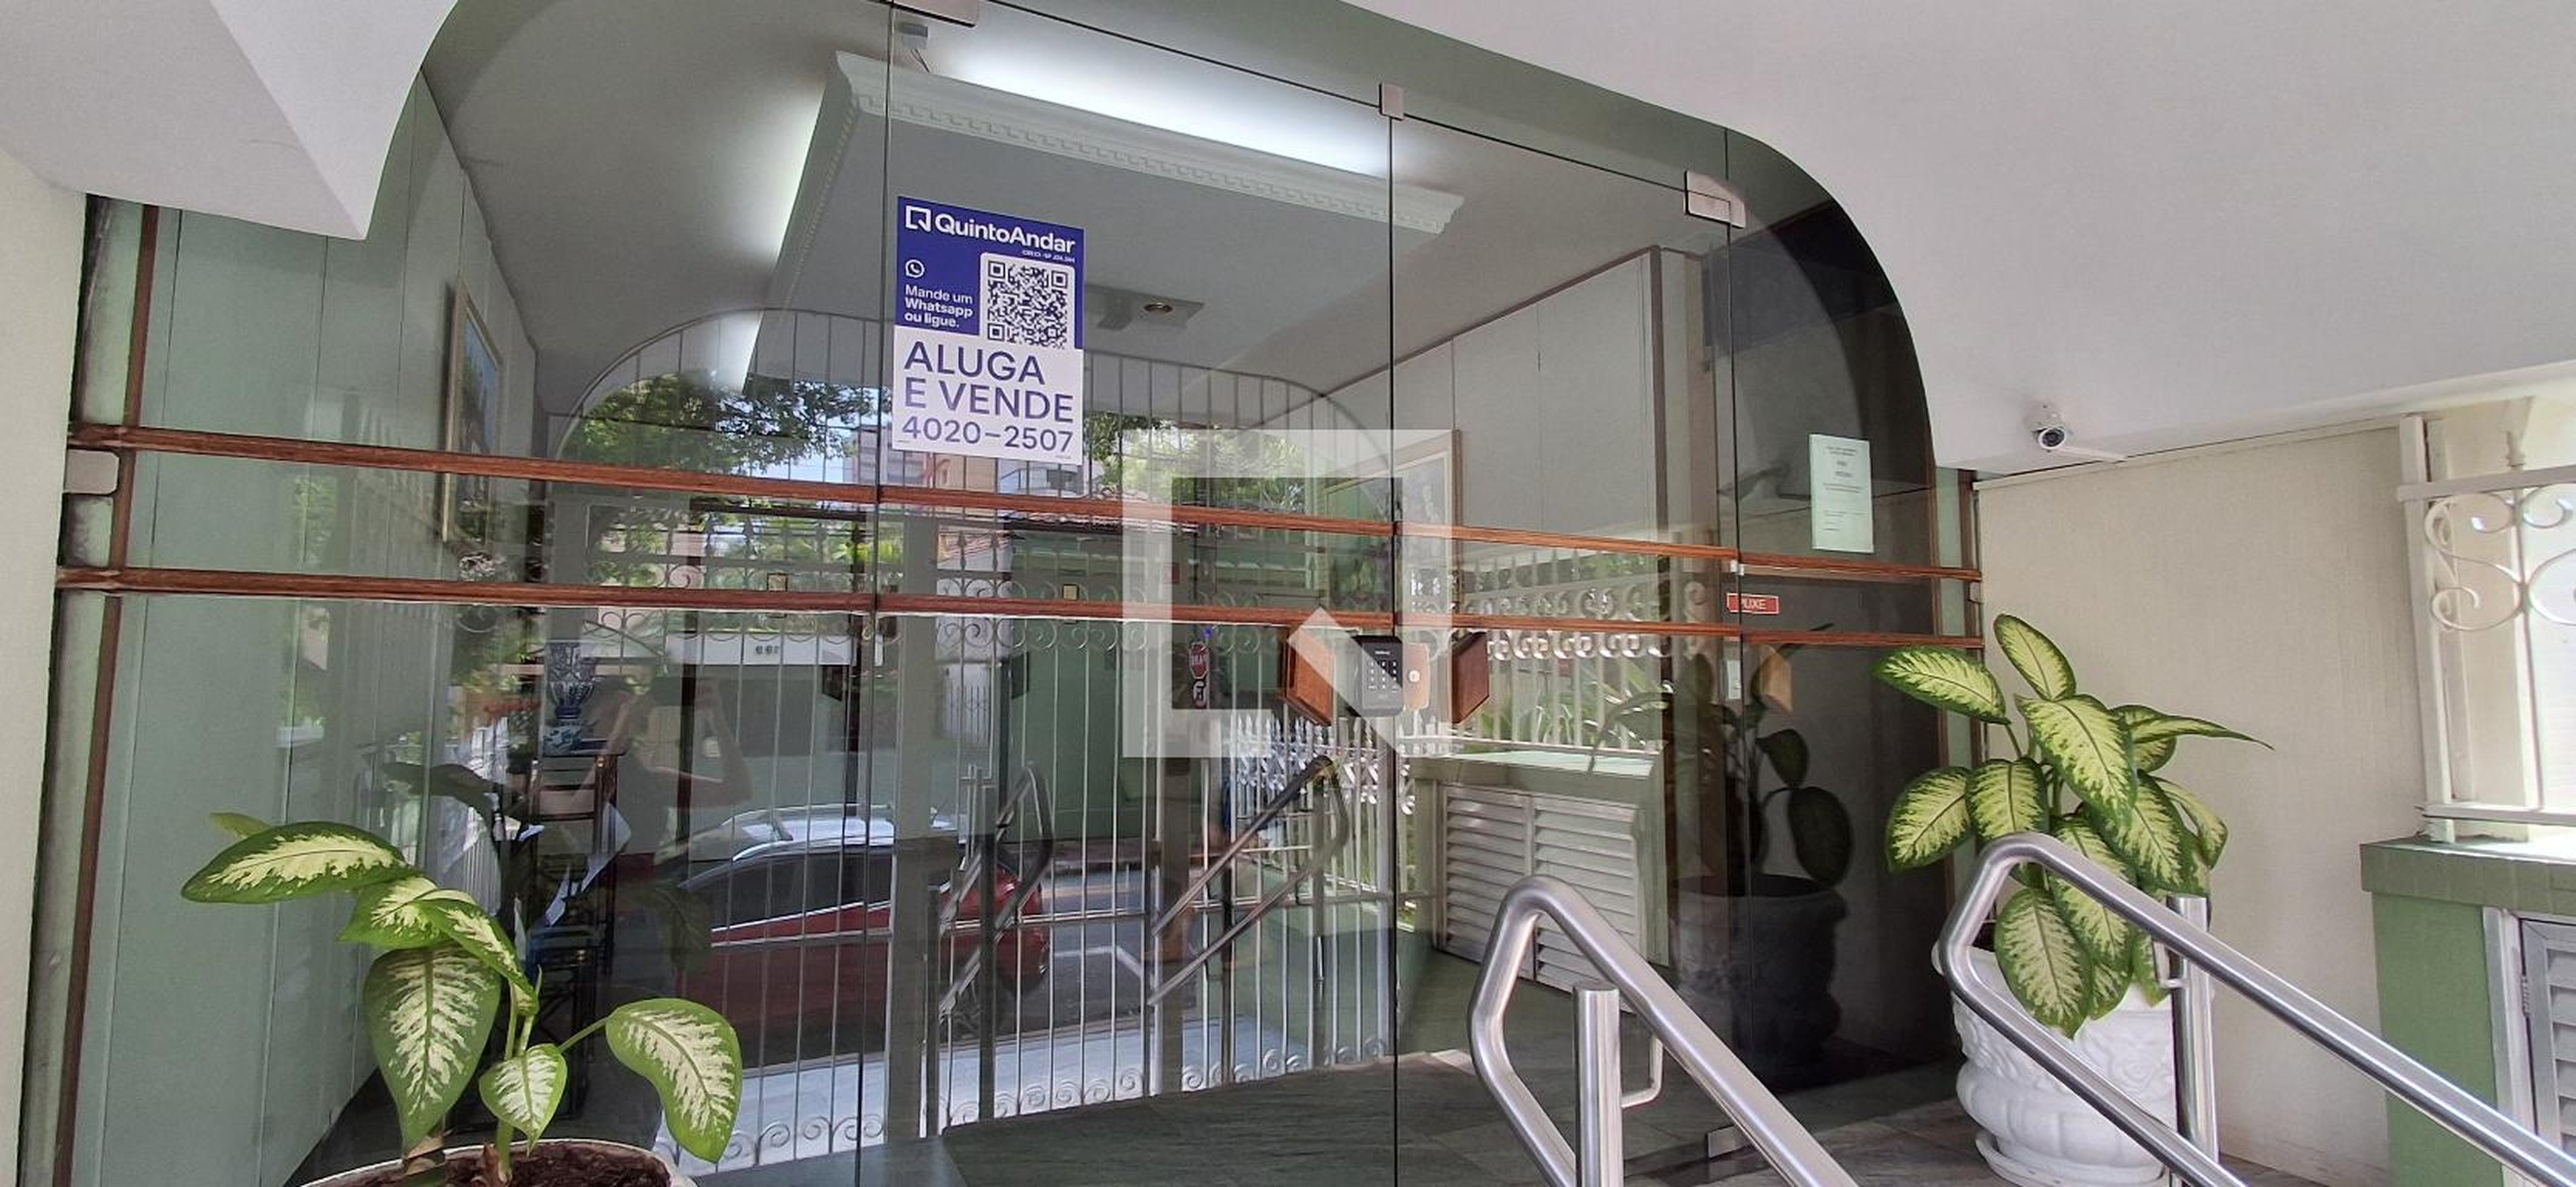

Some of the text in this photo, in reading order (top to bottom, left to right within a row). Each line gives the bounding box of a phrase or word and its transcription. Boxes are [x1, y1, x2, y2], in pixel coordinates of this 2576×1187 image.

[934, 213, 1075, 253] QuintoAndar
[905, 297, 973, 319] Whatsapp
[906, 284, 973, 304] Mande um
[904, 312, 959, 327] ou ligue.
[904, 341, 1045, 385] ALUGA
[906, 377, 1073, 423] E VENDE
[902, 415, 1073, 452] 4020-2507
